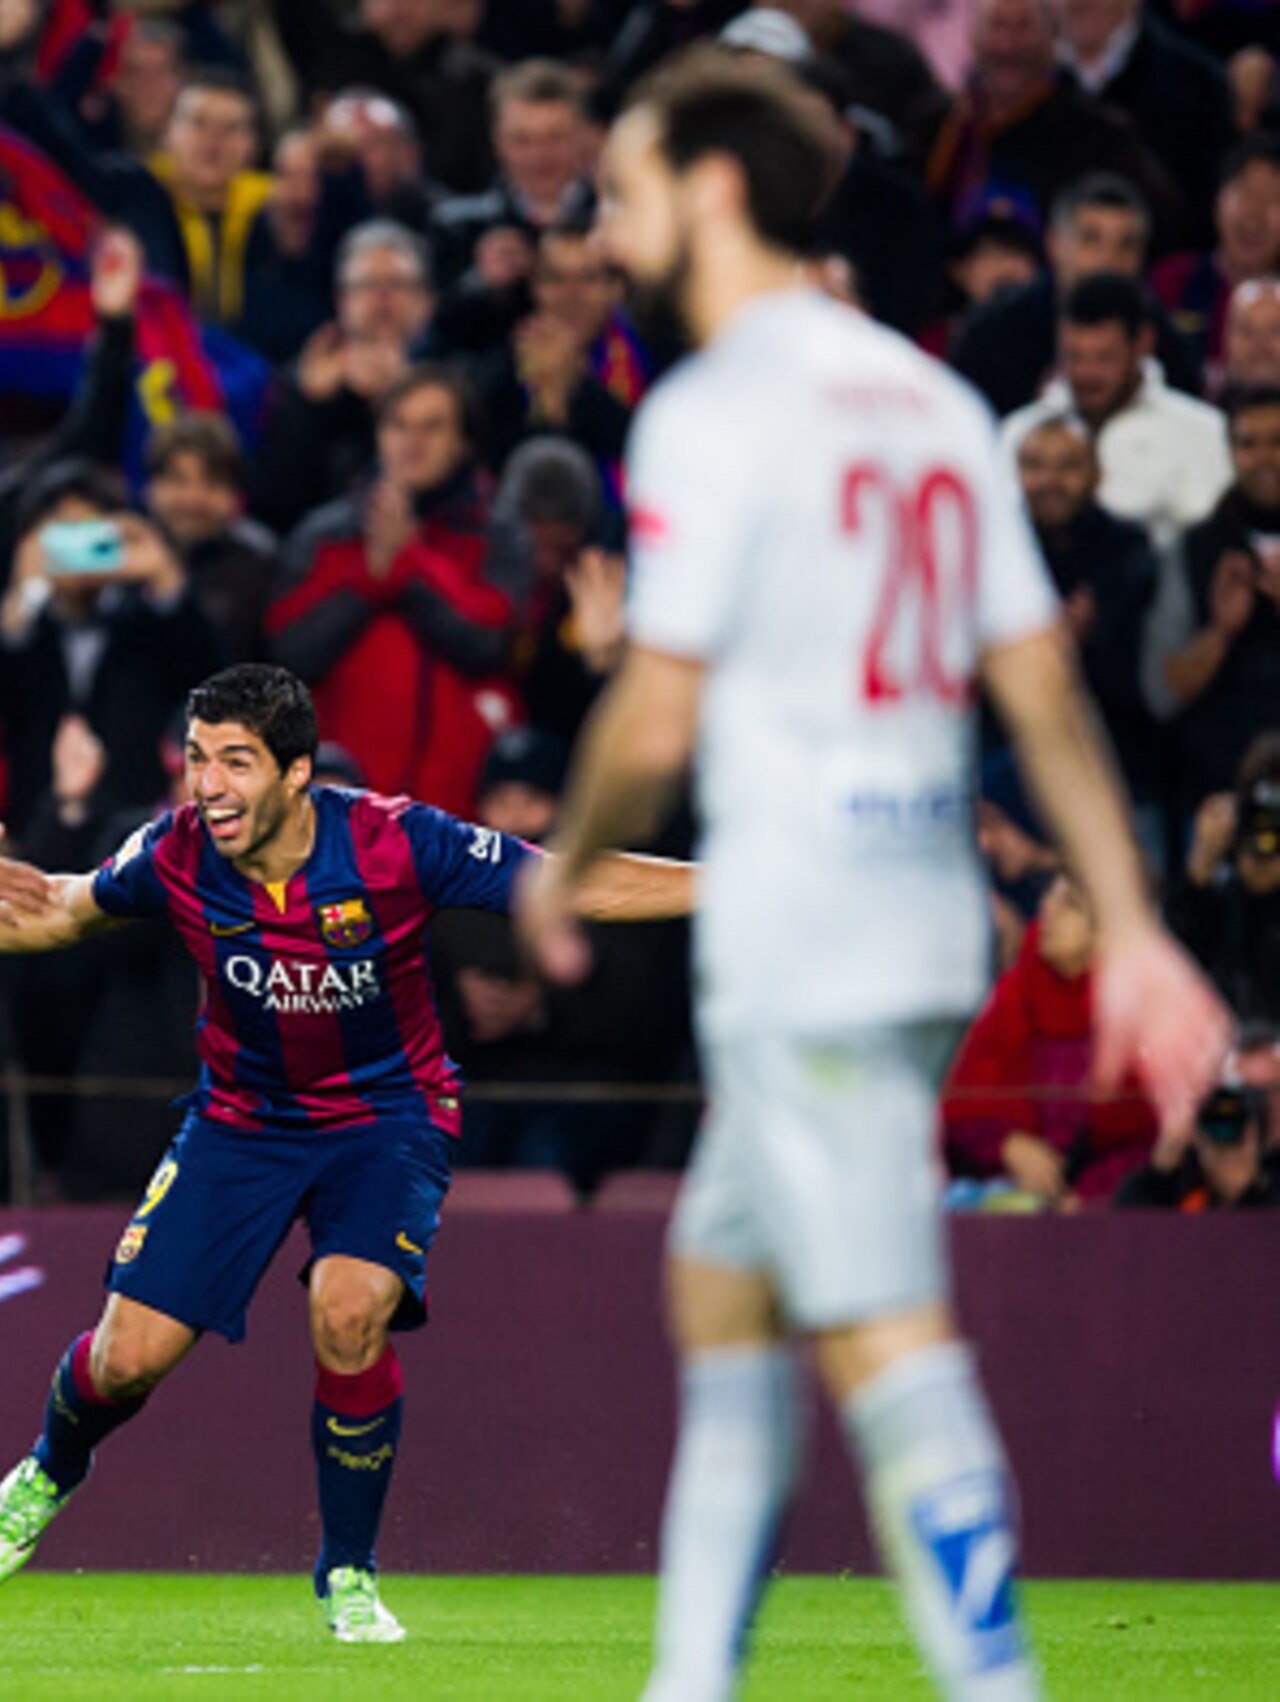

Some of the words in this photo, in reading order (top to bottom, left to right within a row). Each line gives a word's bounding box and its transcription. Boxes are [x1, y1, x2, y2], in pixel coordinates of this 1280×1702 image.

[840, 461, 979, 707] 20
[225, 954, 376, 997] QATAR
[136, 1161, 178, 1218] 9
